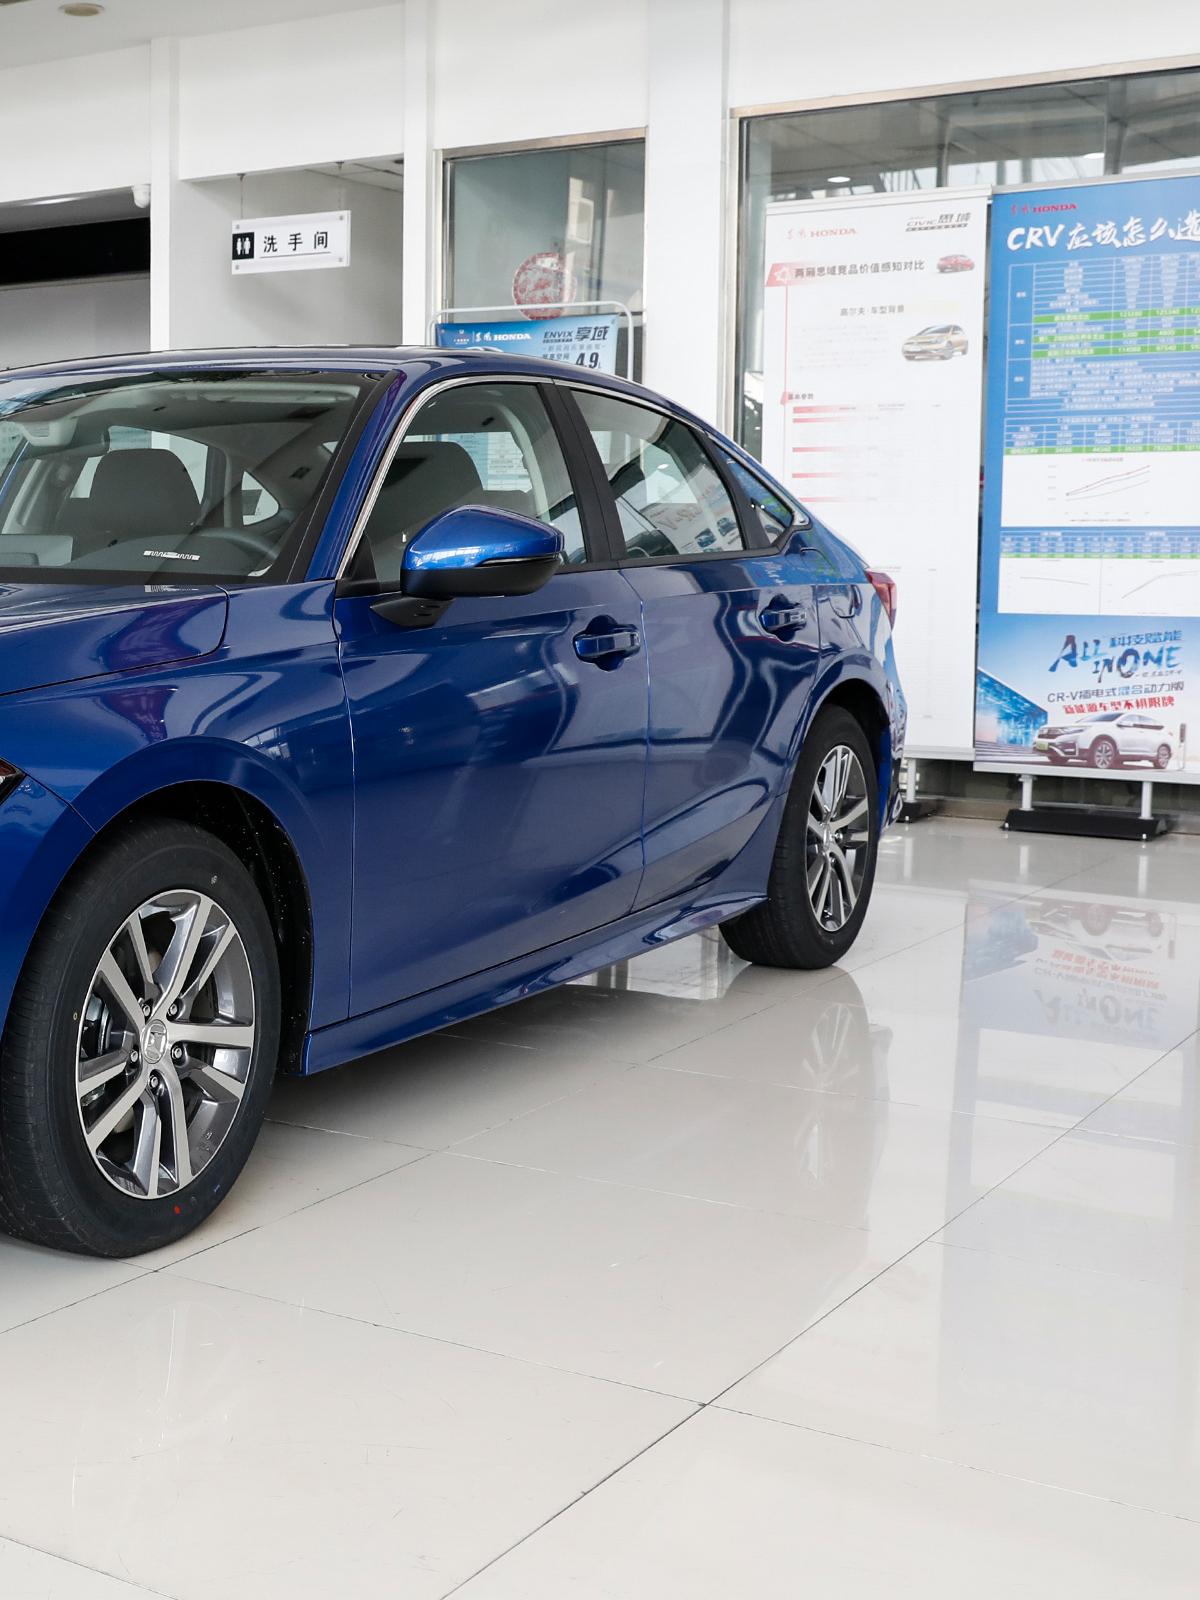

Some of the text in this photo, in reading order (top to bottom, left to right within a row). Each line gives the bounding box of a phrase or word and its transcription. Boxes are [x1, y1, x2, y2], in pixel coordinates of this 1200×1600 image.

[263, 231, 329, 253] 洗手间
[493, 332, 532, 342] HONDA
[543, 331, 573, 339] ENVIX
[575, 325, 610, 342] 享域
